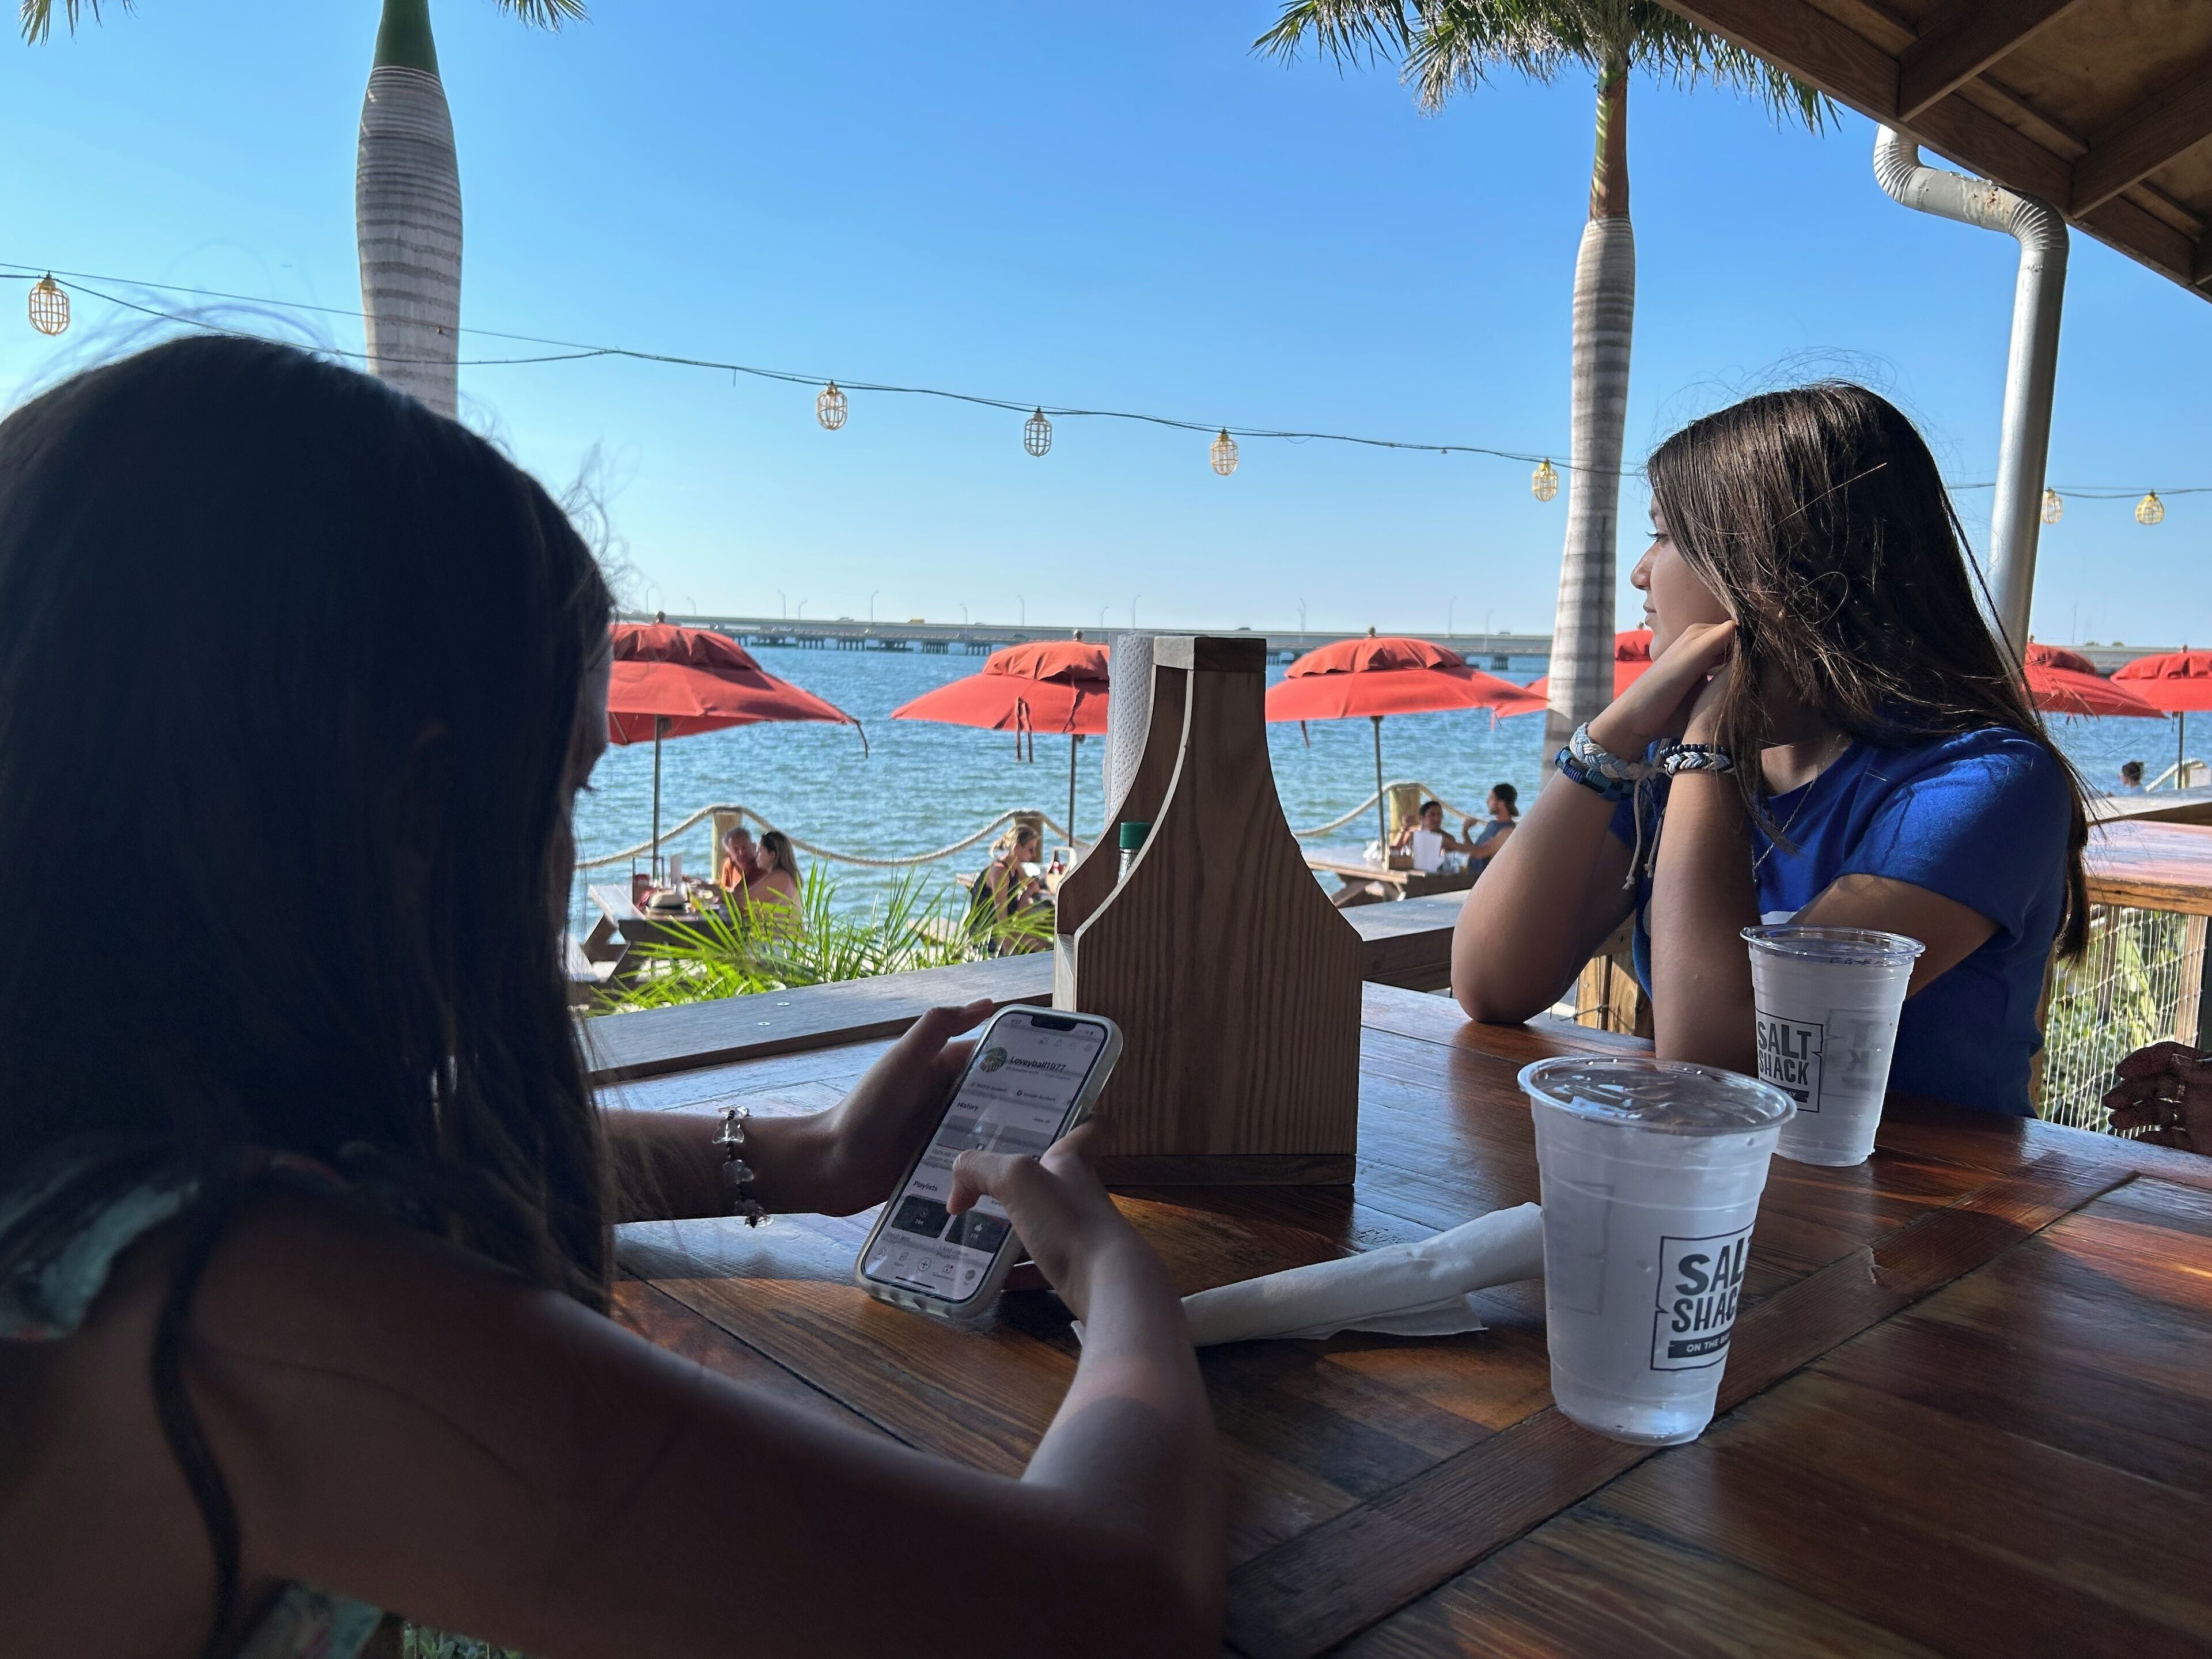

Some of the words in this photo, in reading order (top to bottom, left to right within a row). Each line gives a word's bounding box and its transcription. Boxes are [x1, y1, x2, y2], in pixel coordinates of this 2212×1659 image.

[1758, 1021, 1812, 1060] SALT
[1759, 1049, 1809, 1085] SHACK
[913, 1180, 938, 1191] Playlists
[1676, 1236, 1751, 1296] SAL
[1672, 1286, 1737, 1333] SHAC
[1686, 1343, 1702, 1353] ON
[1704, 1338, 1719, 1350] THE
